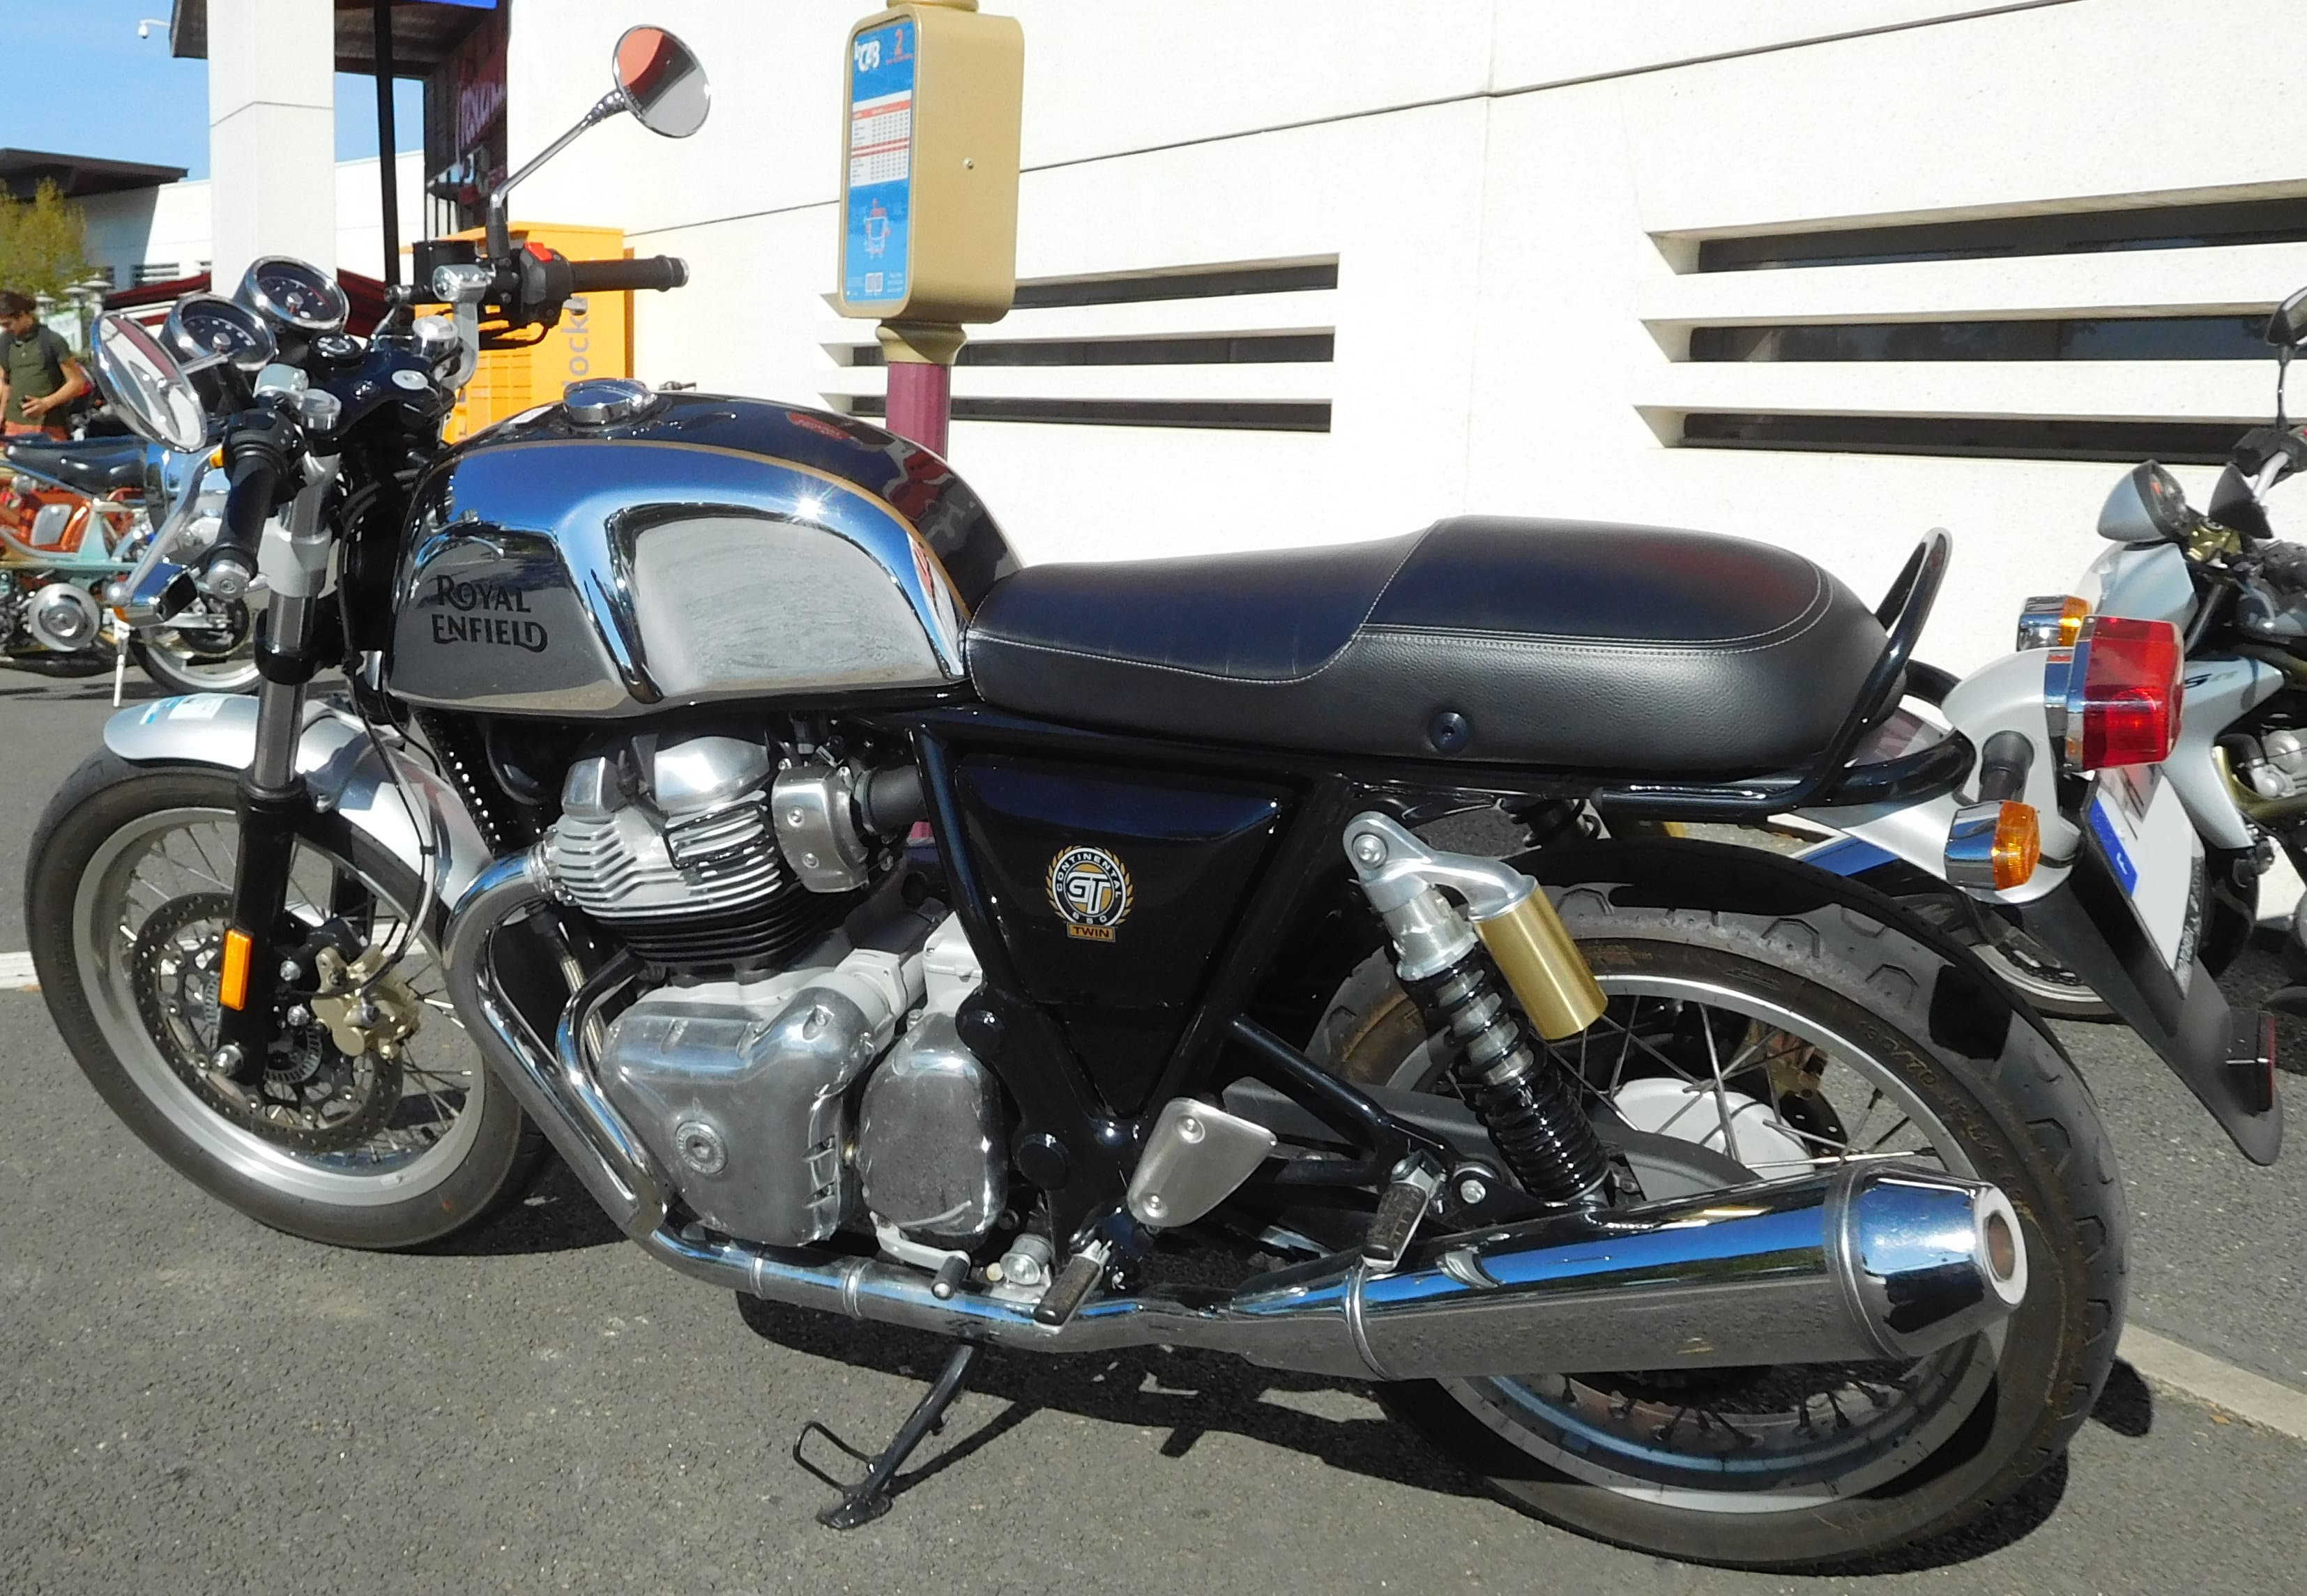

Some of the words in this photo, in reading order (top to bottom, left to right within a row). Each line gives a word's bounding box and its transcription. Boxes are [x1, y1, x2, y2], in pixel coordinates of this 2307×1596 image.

[436, 574, 531, 613] ROYAL
[432, 614, 548, 653] ENFIELD
[1056, 853, 1122, 899] CONTINENTAL
[1066, 872, 1112, 914] GT
[1072, 926, 1109, 938] TWIN
